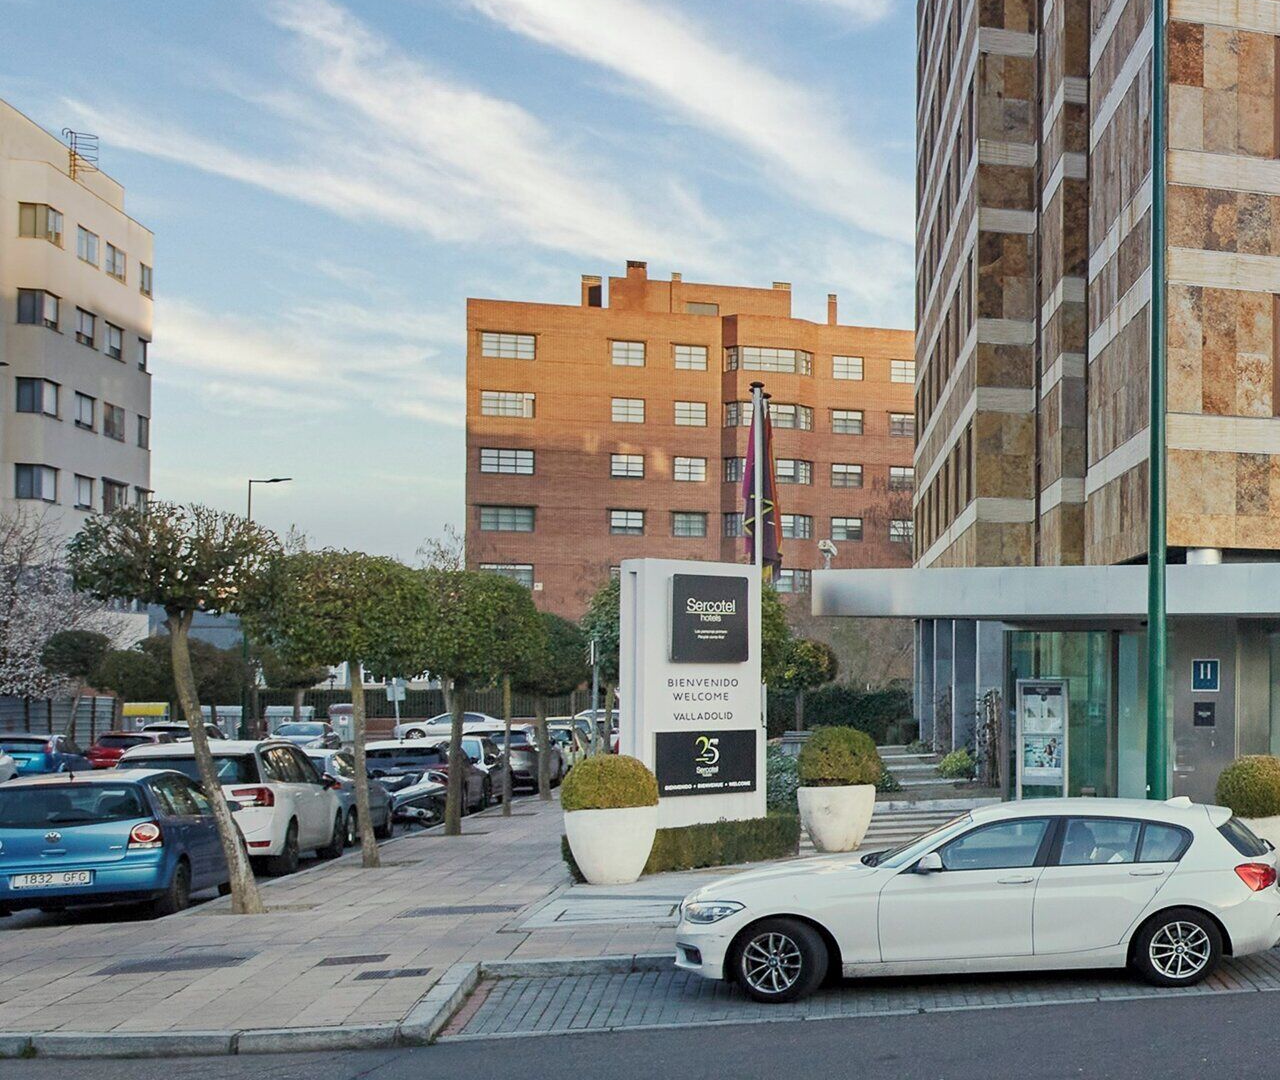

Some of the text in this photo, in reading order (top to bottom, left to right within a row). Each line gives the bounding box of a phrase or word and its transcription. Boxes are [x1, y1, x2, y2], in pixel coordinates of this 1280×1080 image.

[686, 597, 736, 612] Sercotel
[667, 678, 739, 688] BIENVENIDO
[672, 692, 729, 701] WELCOME
[673, 711, 734, 720] VALLADOLID
[695, 736, 719, 765] 25
[24, 872, 87, 885] 1832 GFG
